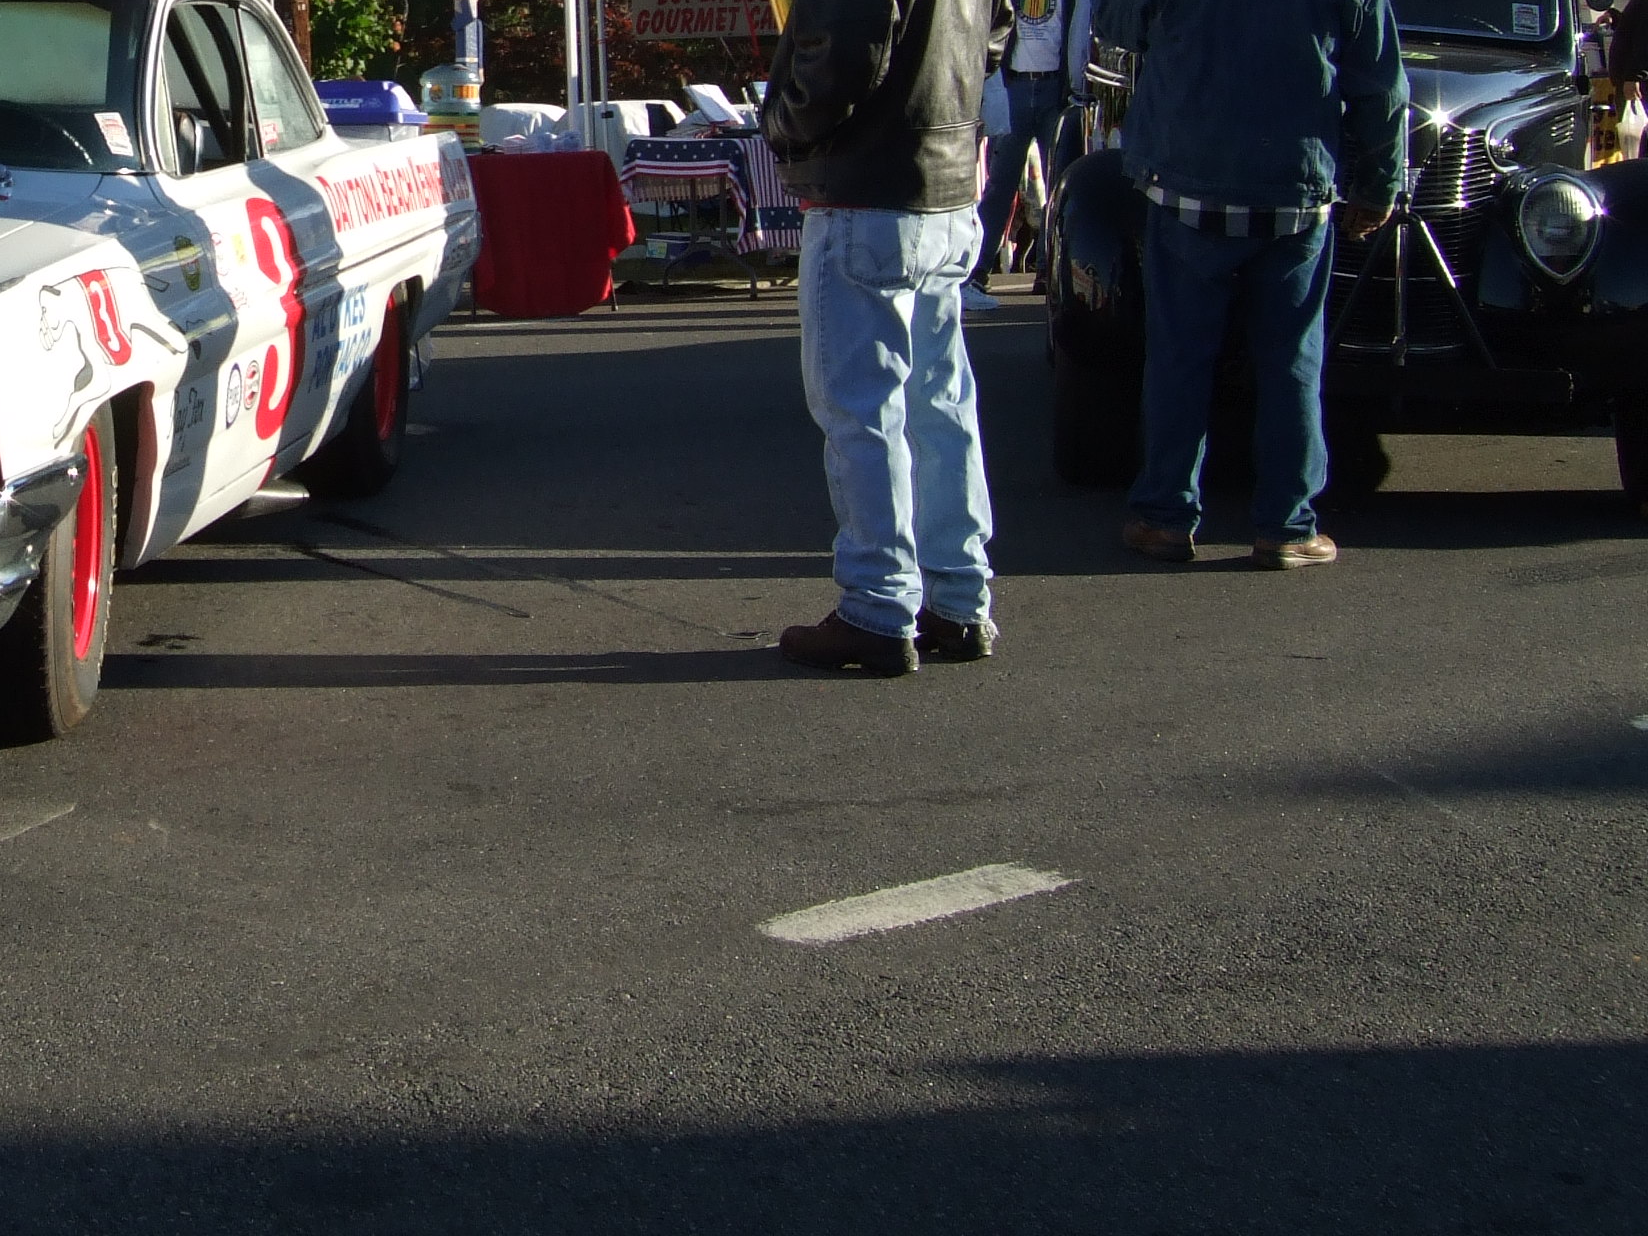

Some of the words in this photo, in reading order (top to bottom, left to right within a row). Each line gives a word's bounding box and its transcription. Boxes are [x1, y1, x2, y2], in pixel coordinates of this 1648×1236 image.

[636, 6, 740, 35] GOURMET
[315, 175, 386, 233] DAYTONA
[373, 162, 420, 217] BEACH
[90, 280, 121, 353] 3
[245, 197, 308, 441] 3
